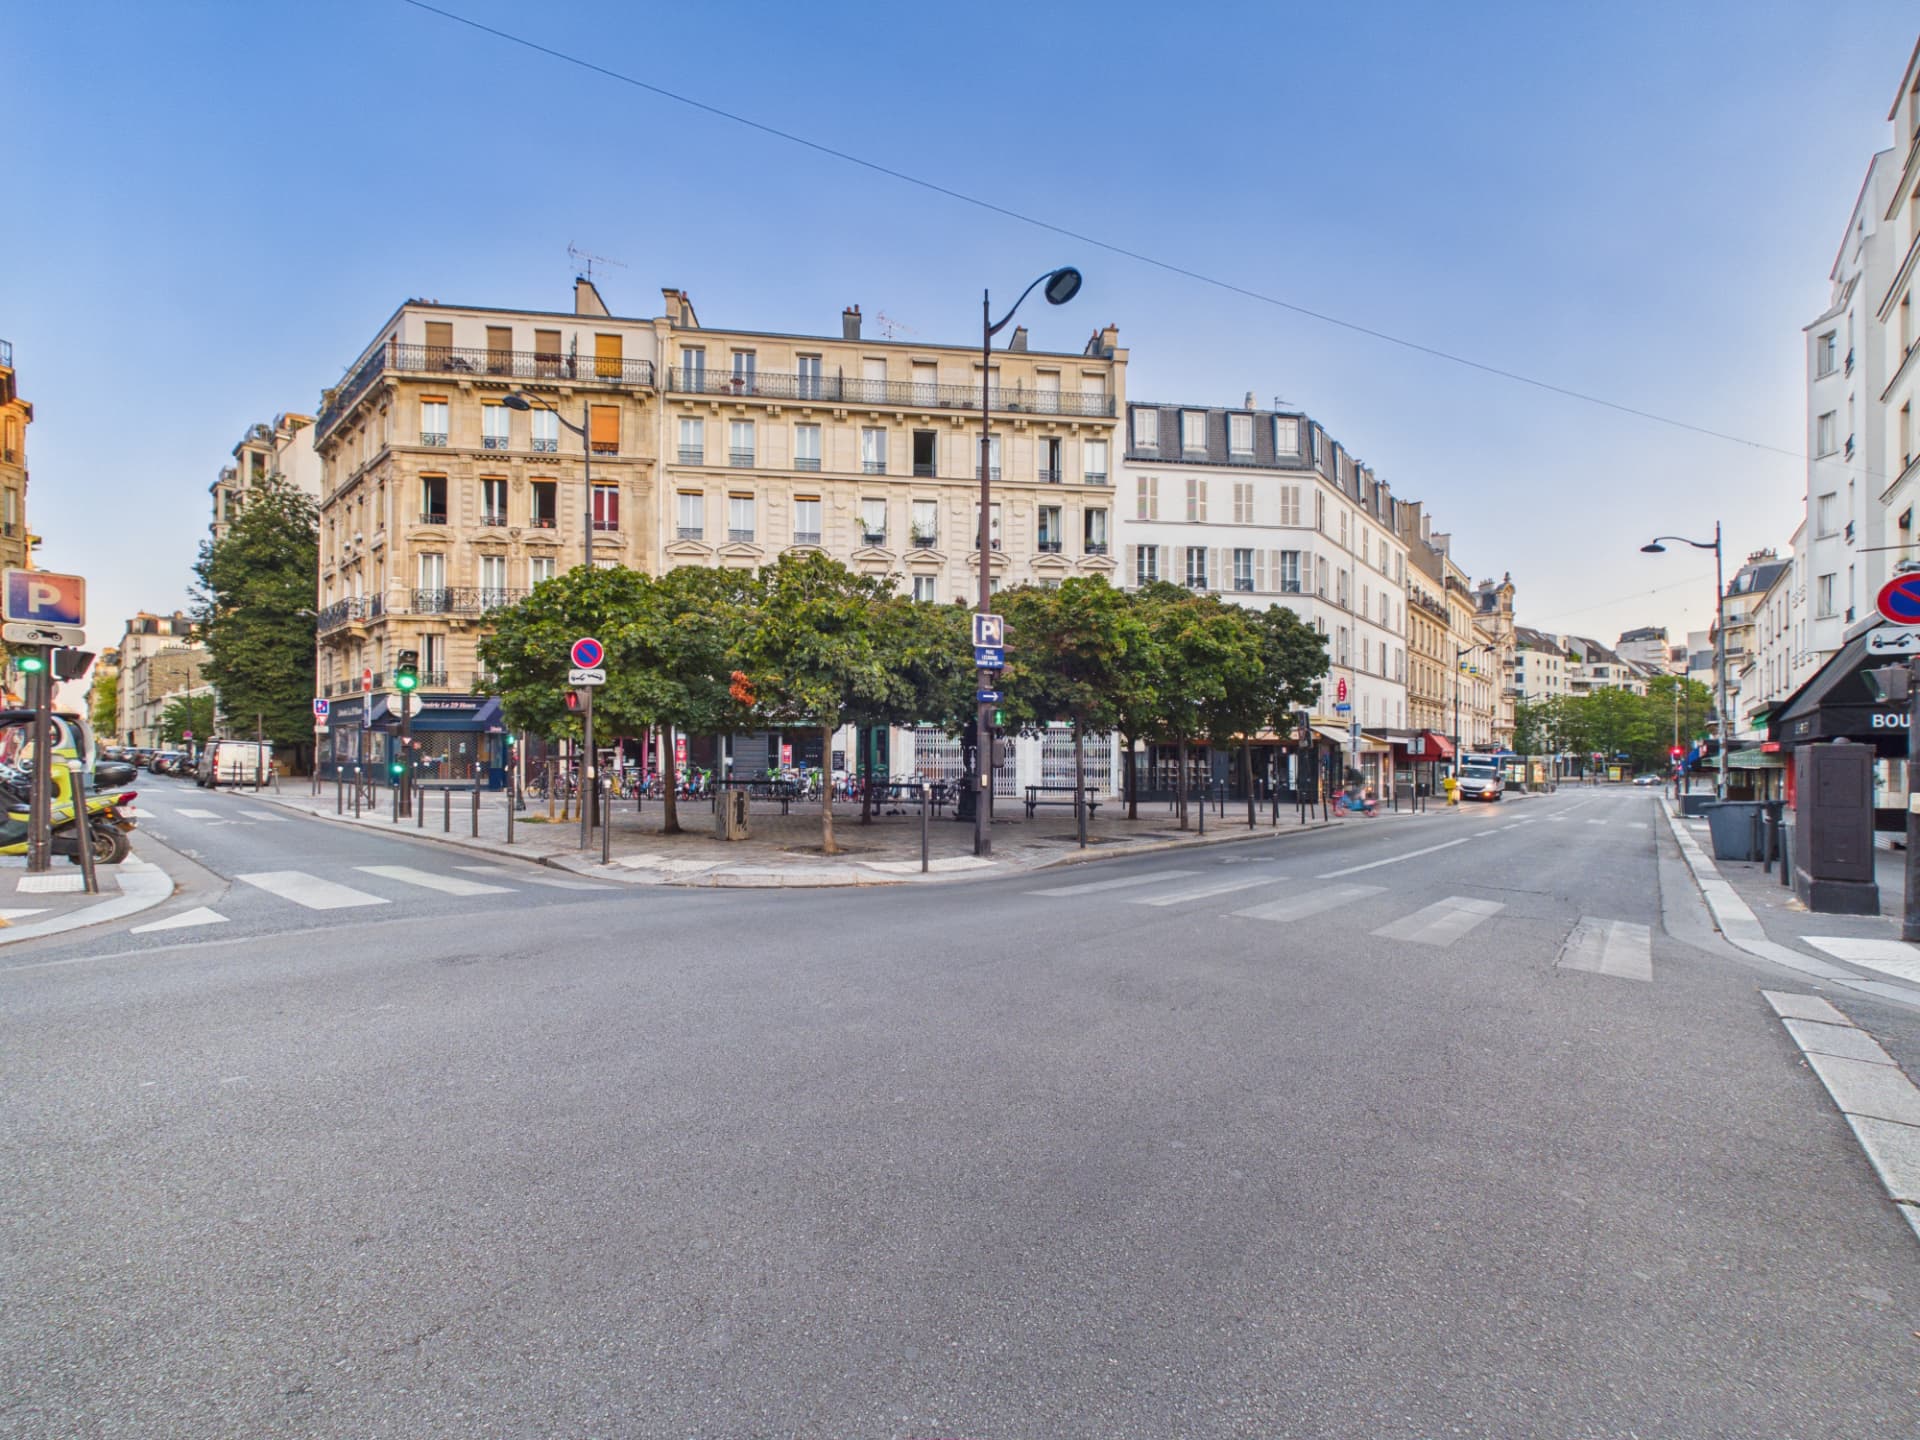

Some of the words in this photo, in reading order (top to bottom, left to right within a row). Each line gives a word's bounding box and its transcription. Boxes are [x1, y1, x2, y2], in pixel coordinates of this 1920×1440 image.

[28, 582, 61, 613] P
[981, 621, 995, 640] P
[1872, 713, 1910, 728] BOU
